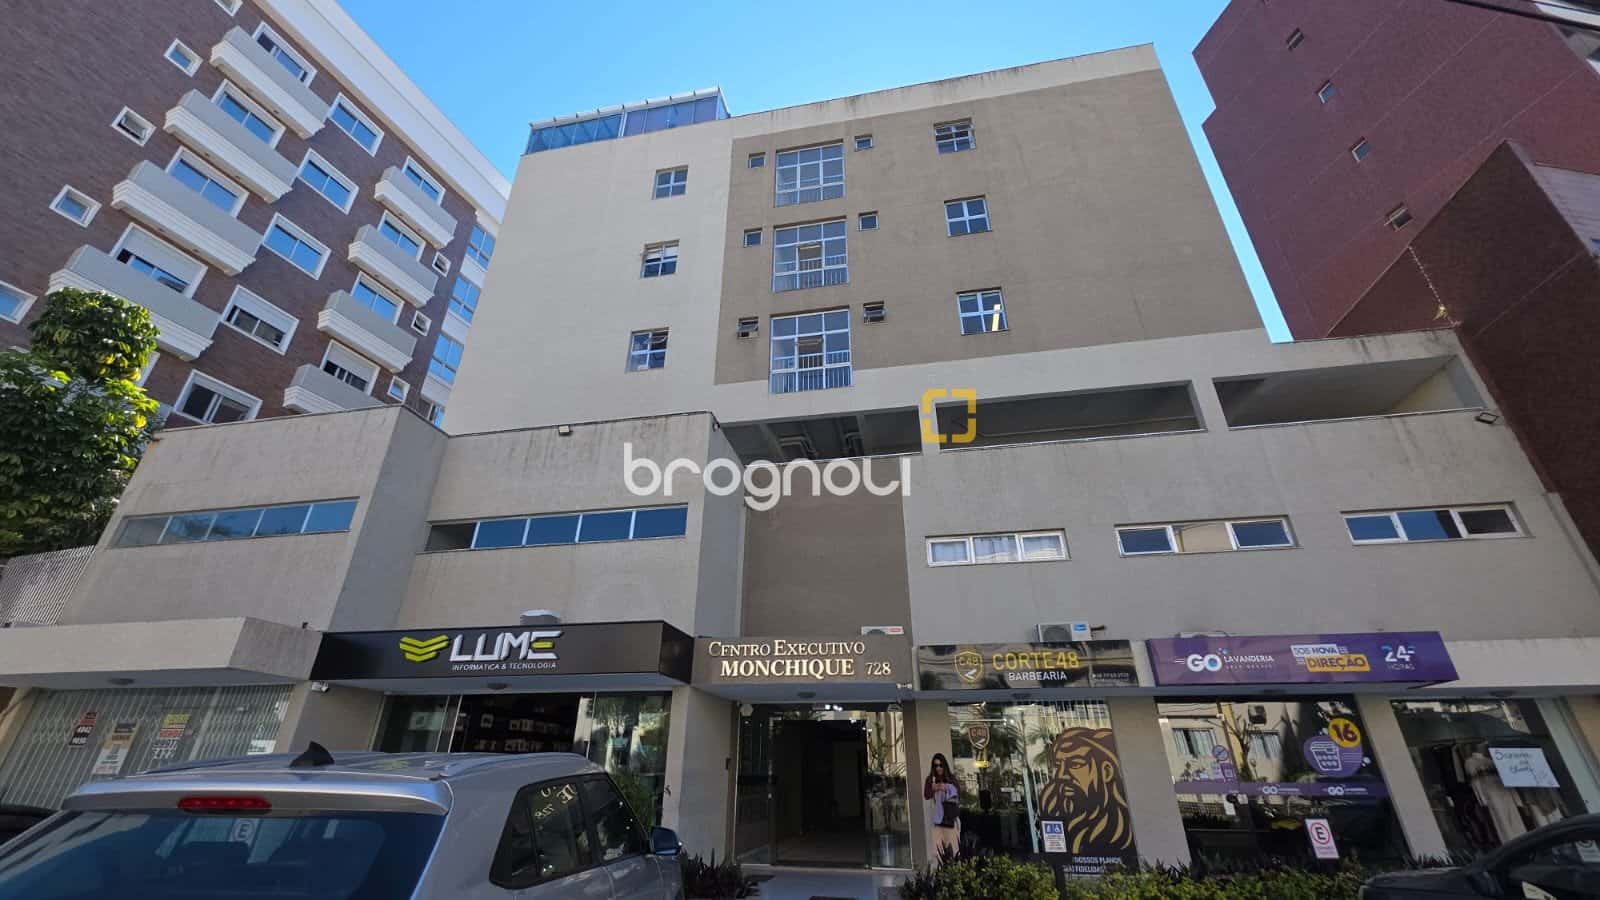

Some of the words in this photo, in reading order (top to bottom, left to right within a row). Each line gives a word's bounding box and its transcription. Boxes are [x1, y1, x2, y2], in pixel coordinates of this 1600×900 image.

[450, 631, 562, 661] LUME
[708, 641, 770, 656] CENTRO
[773, 639, 865, 656] EXECUTIVO
[509, 662, 556, 670] TECNOLOGIA
[992, 652, 1080, 670] CORTE48
[1187, 654, 1222, 672] GO
[1223, 655, 1274, 663] LAVANDERIA
[1307, 655, 1366, 671] DIREÇÃO
[720, 659, 854, 679] MONCHIQUE
[866, 662, 891, 675] 728
[1008, 671, 1067, 681] BARBEARIA
[1331, 723, 1358, 742] 16
[1315, 827, 1326, 840] E
